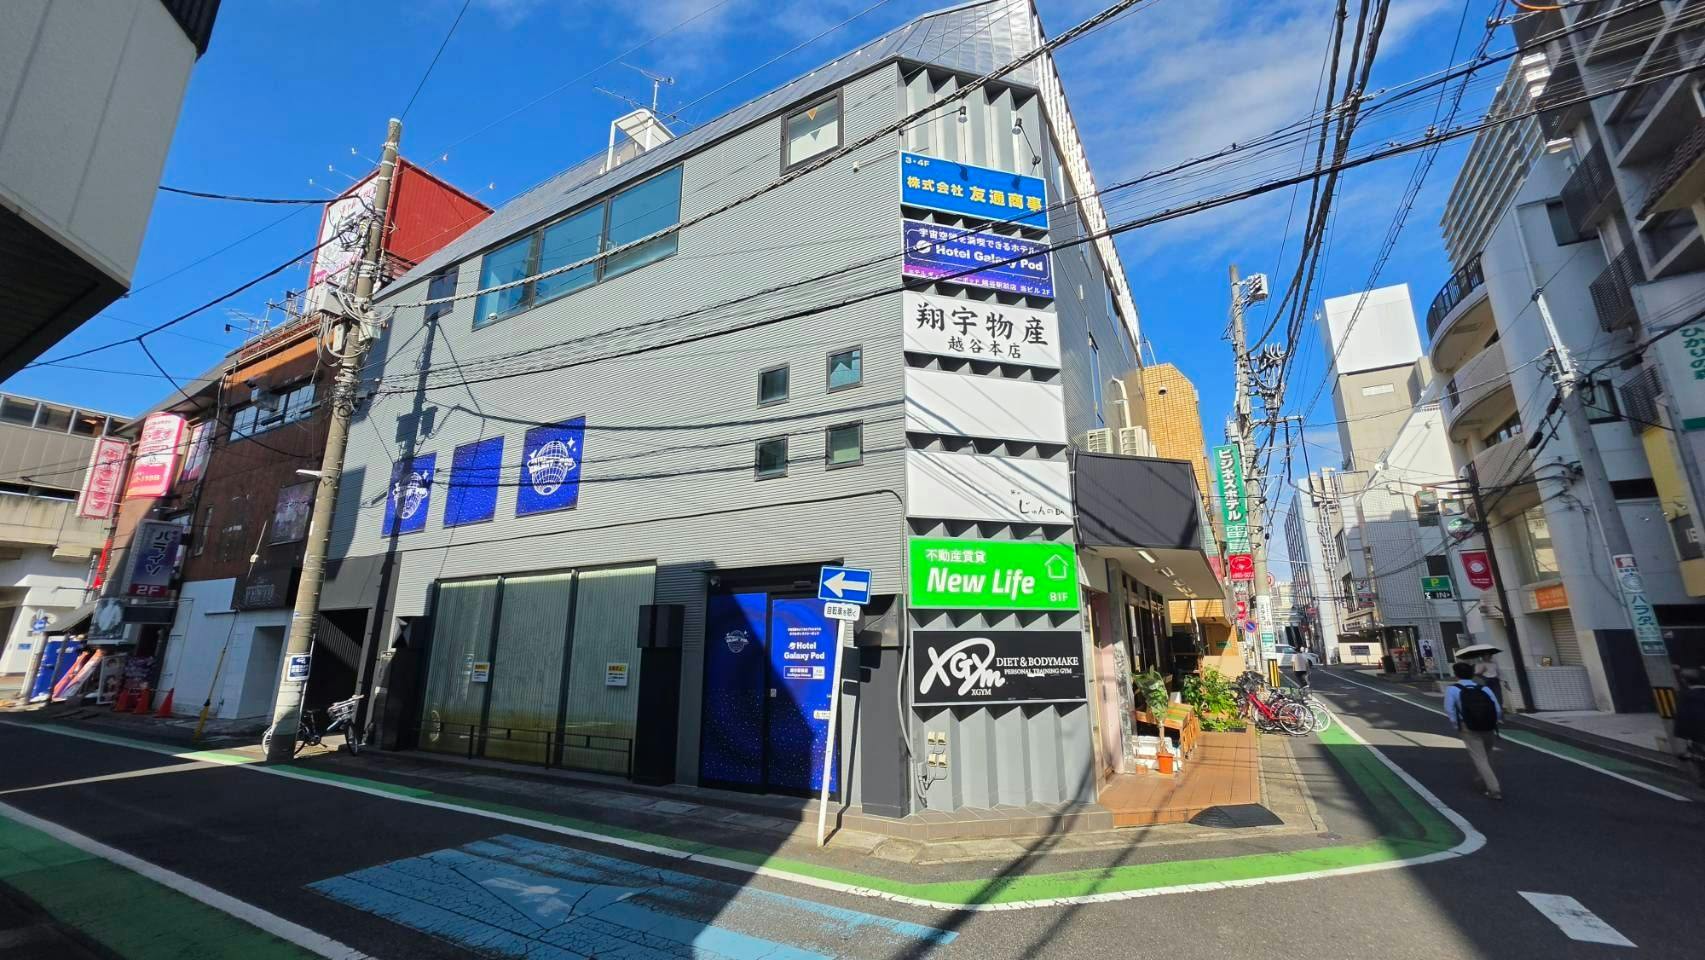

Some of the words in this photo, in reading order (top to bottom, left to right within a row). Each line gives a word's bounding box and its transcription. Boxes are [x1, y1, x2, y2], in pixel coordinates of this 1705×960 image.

[907, 175, 964, 197] 株式会社
[969, 185, 1042, 212] 友通商事
[935, 245, 970, 259] Hotel
[1020, 258, 1043, 271] Pod
[916, 302, 1048, 346] 翔宇物産
[948, 336, 1021, 359] 越谷本店
[1218, 449, 1242, 521] ビジネスホテル
[925, 549, 987, 563] 不動産賃貸
[136, 585, 160, 595] 2F
[926, 567, 987, 593] New
[991, 568, 1036, 601] Life
[1050, 592, 1069, 602] B1F
[796, 642, 817, 650] Hotel
[784, 652, 809, 661] Galaxy
[996, 657, 1020, 667] DIET
[1028, 656, 1079, 666] BODYMAKE
[971, 688, 992, 696] XGYM
